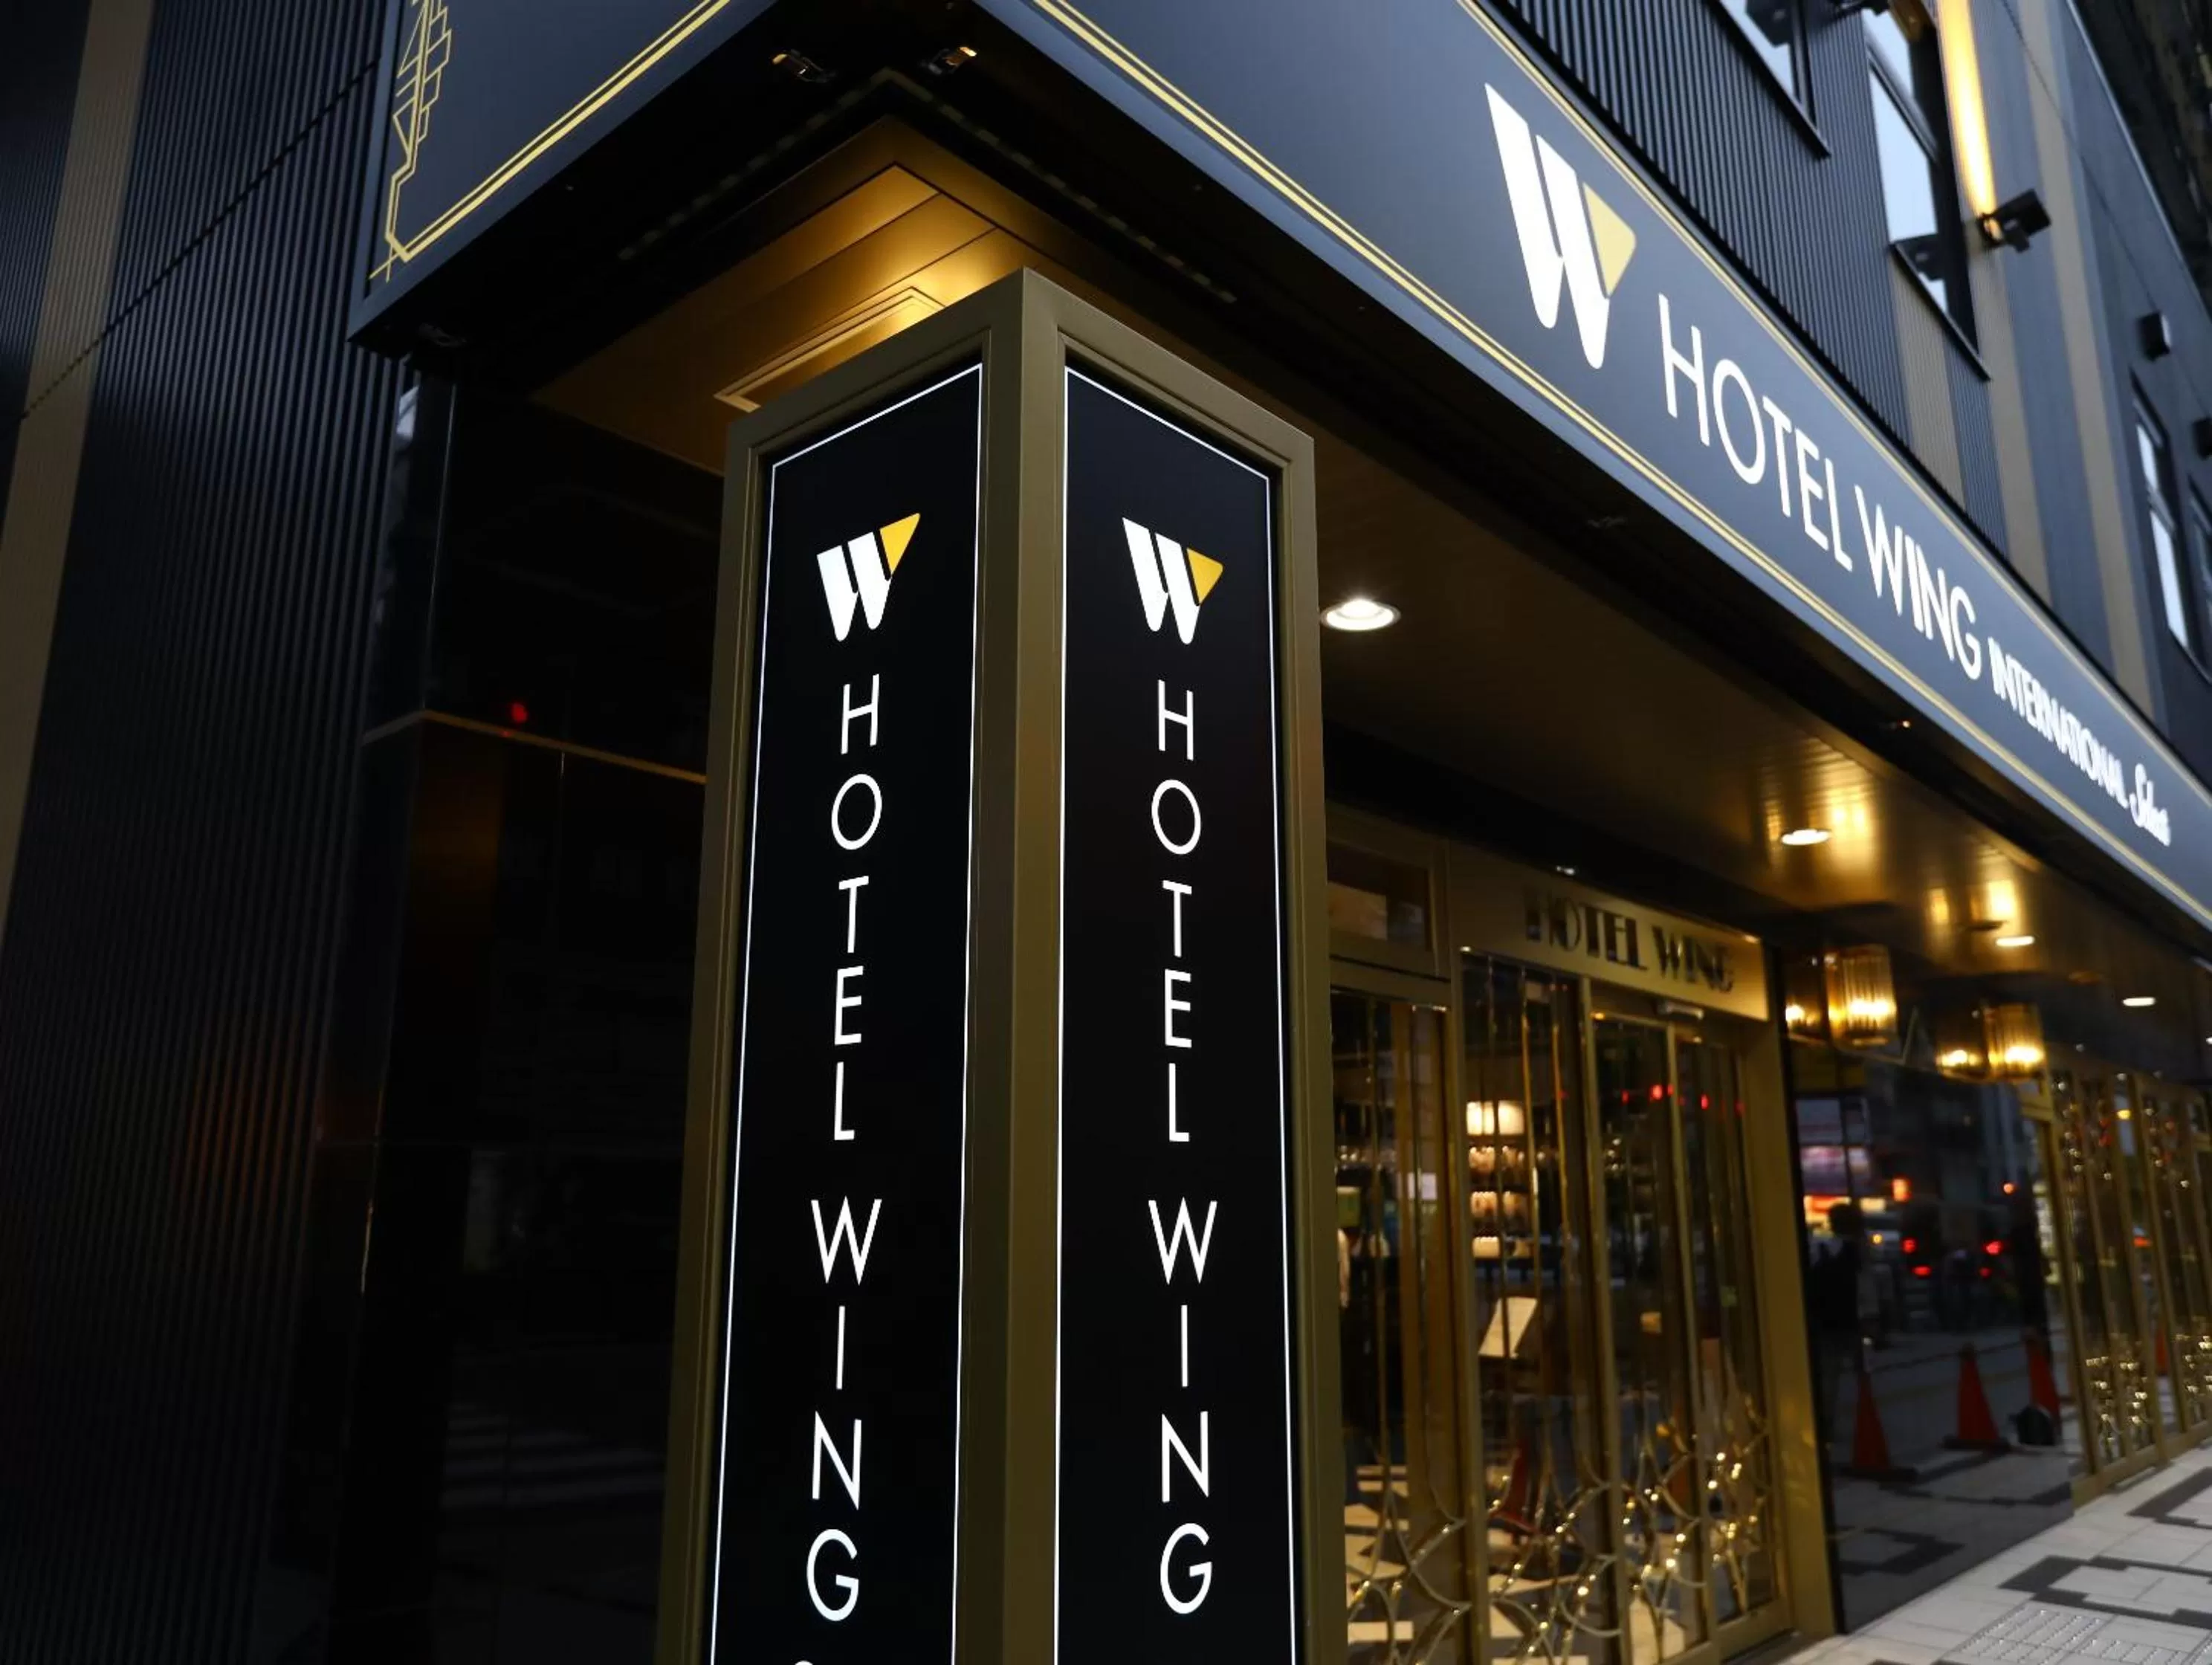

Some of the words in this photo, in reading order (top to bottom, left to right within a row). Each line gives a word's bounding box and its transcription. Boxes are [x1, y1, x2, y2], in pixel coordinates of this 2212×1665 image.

[1658, 291, 1854, 572] HOTEL
[1853, 483, 1983, 681] WING
[1987, 636, 2129, 810] INTERNATIONAL
[830, 673, 883, 1142] HOTEL
[1151, 679, 1202, 1143] HOTEL
[1524, 889, 1648, 970] HOTEL
[806, 1195, 883, 1623] WING
[1148, 1196, 1218, 1615] WING
